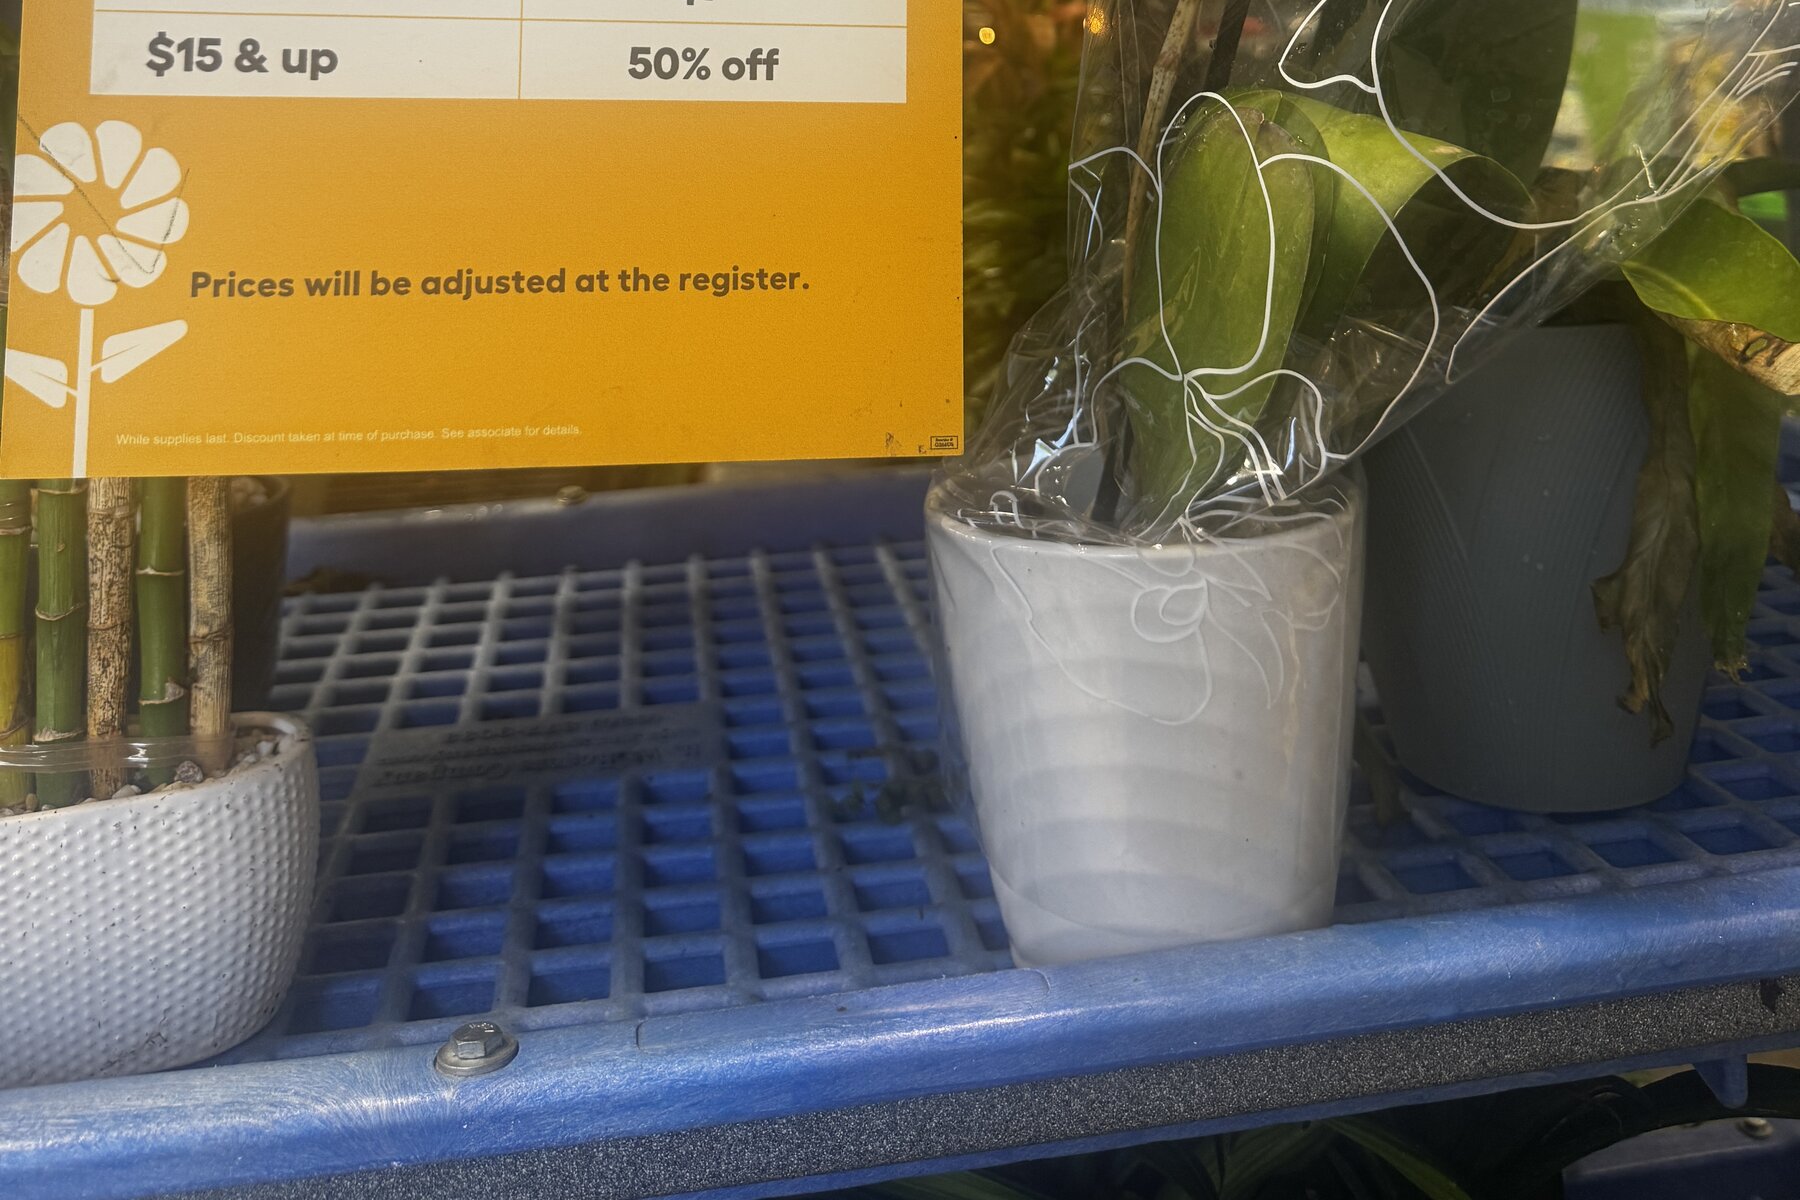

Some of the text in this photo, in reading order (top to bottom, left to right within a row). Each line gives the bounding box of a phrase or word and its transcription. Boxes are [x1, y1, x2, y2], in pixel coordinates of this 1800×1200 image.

[146, 31, 339, 81] $15 & up
[627, 46, 780, 81] 50% off
[191, 265, 810, 301] Prices will be adjusted at the register.
[116, 433, 150, 445] While
[153, 433, 202, 447] supplies
[234, 431, 285, 443] Discount
[288, 430, 321, 442] taken
[323, 431, 336, 442] at
[339, 430, 363, 442] time
[367, 429, 378, 441] of
[441, 427, 465, 439] See
[467, 425, 522, 438] associate
[525, 425, 540, 437] for
[543, 424, 583, 436] details.
